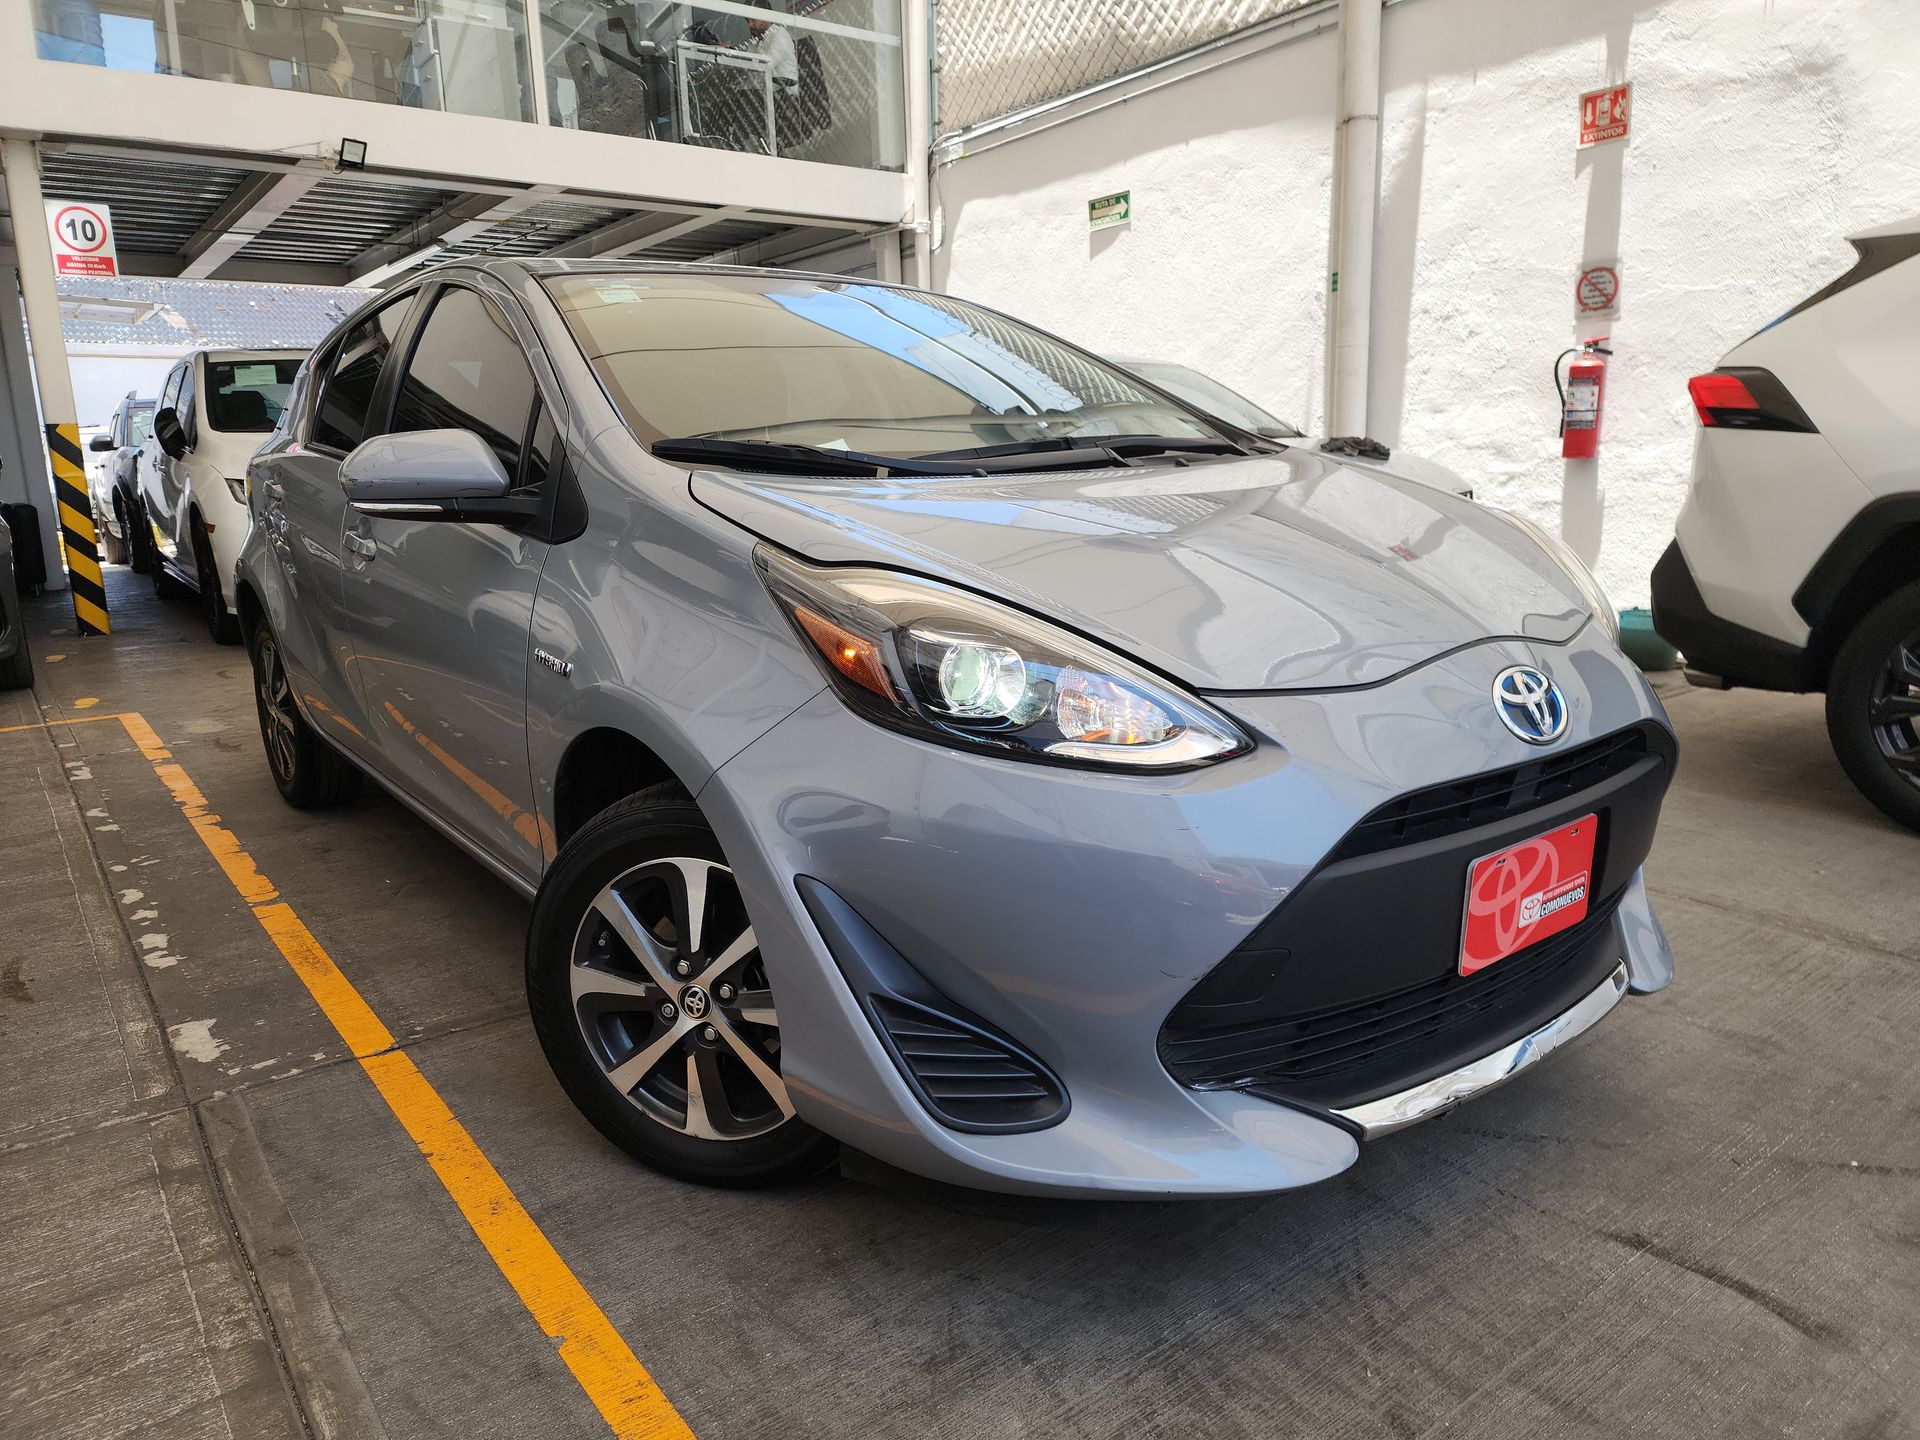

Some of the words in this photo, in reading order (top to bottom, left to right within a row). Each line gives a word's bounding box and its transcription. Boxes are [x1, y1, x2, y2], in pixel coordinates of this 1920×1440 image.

[1583, 126, 1625, 143] EXTINTOR
[66, 218, 97, 242] 10
[1541, 886, 1584, 916] COMONUEVOS
